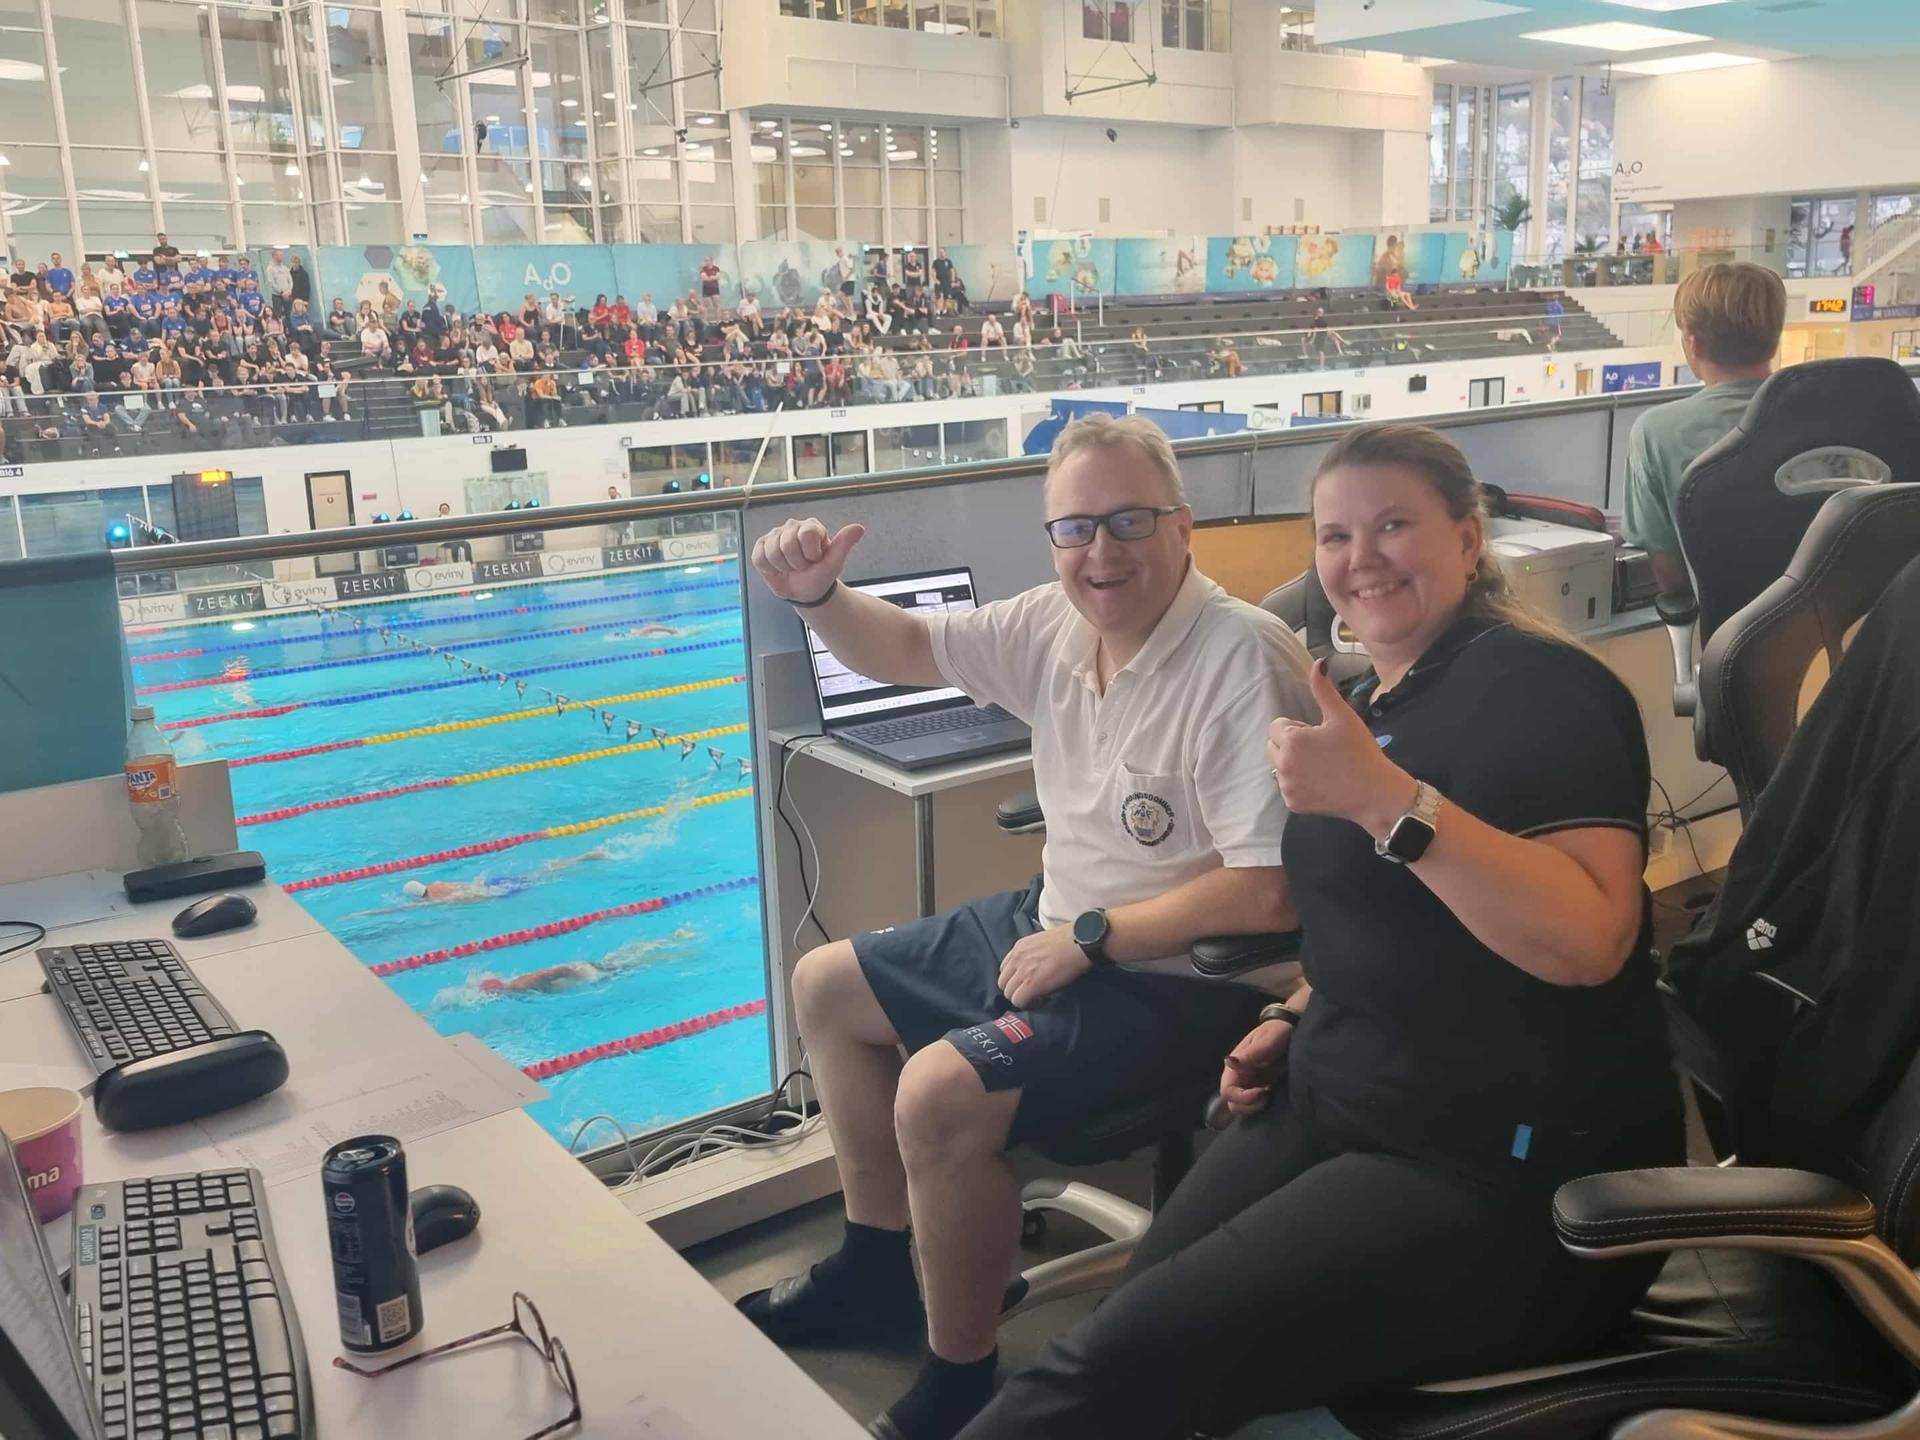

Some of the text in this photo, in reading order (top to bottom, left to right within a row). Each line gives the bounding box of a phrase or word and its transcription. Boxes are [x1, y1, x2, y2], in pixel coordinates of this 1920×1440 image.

[566, 554, 595, 567] eviny
[609, 546, 653, 562] ZEEKIT
[434, 568, 464, 581] eviny
[483, 561, 532, 578] ZEEKIT
[294, 584, 329, 600] eviny
[342, 576, 396, 594] ZEEKIT
[196, 593, 254, 611] ZEEKIT
